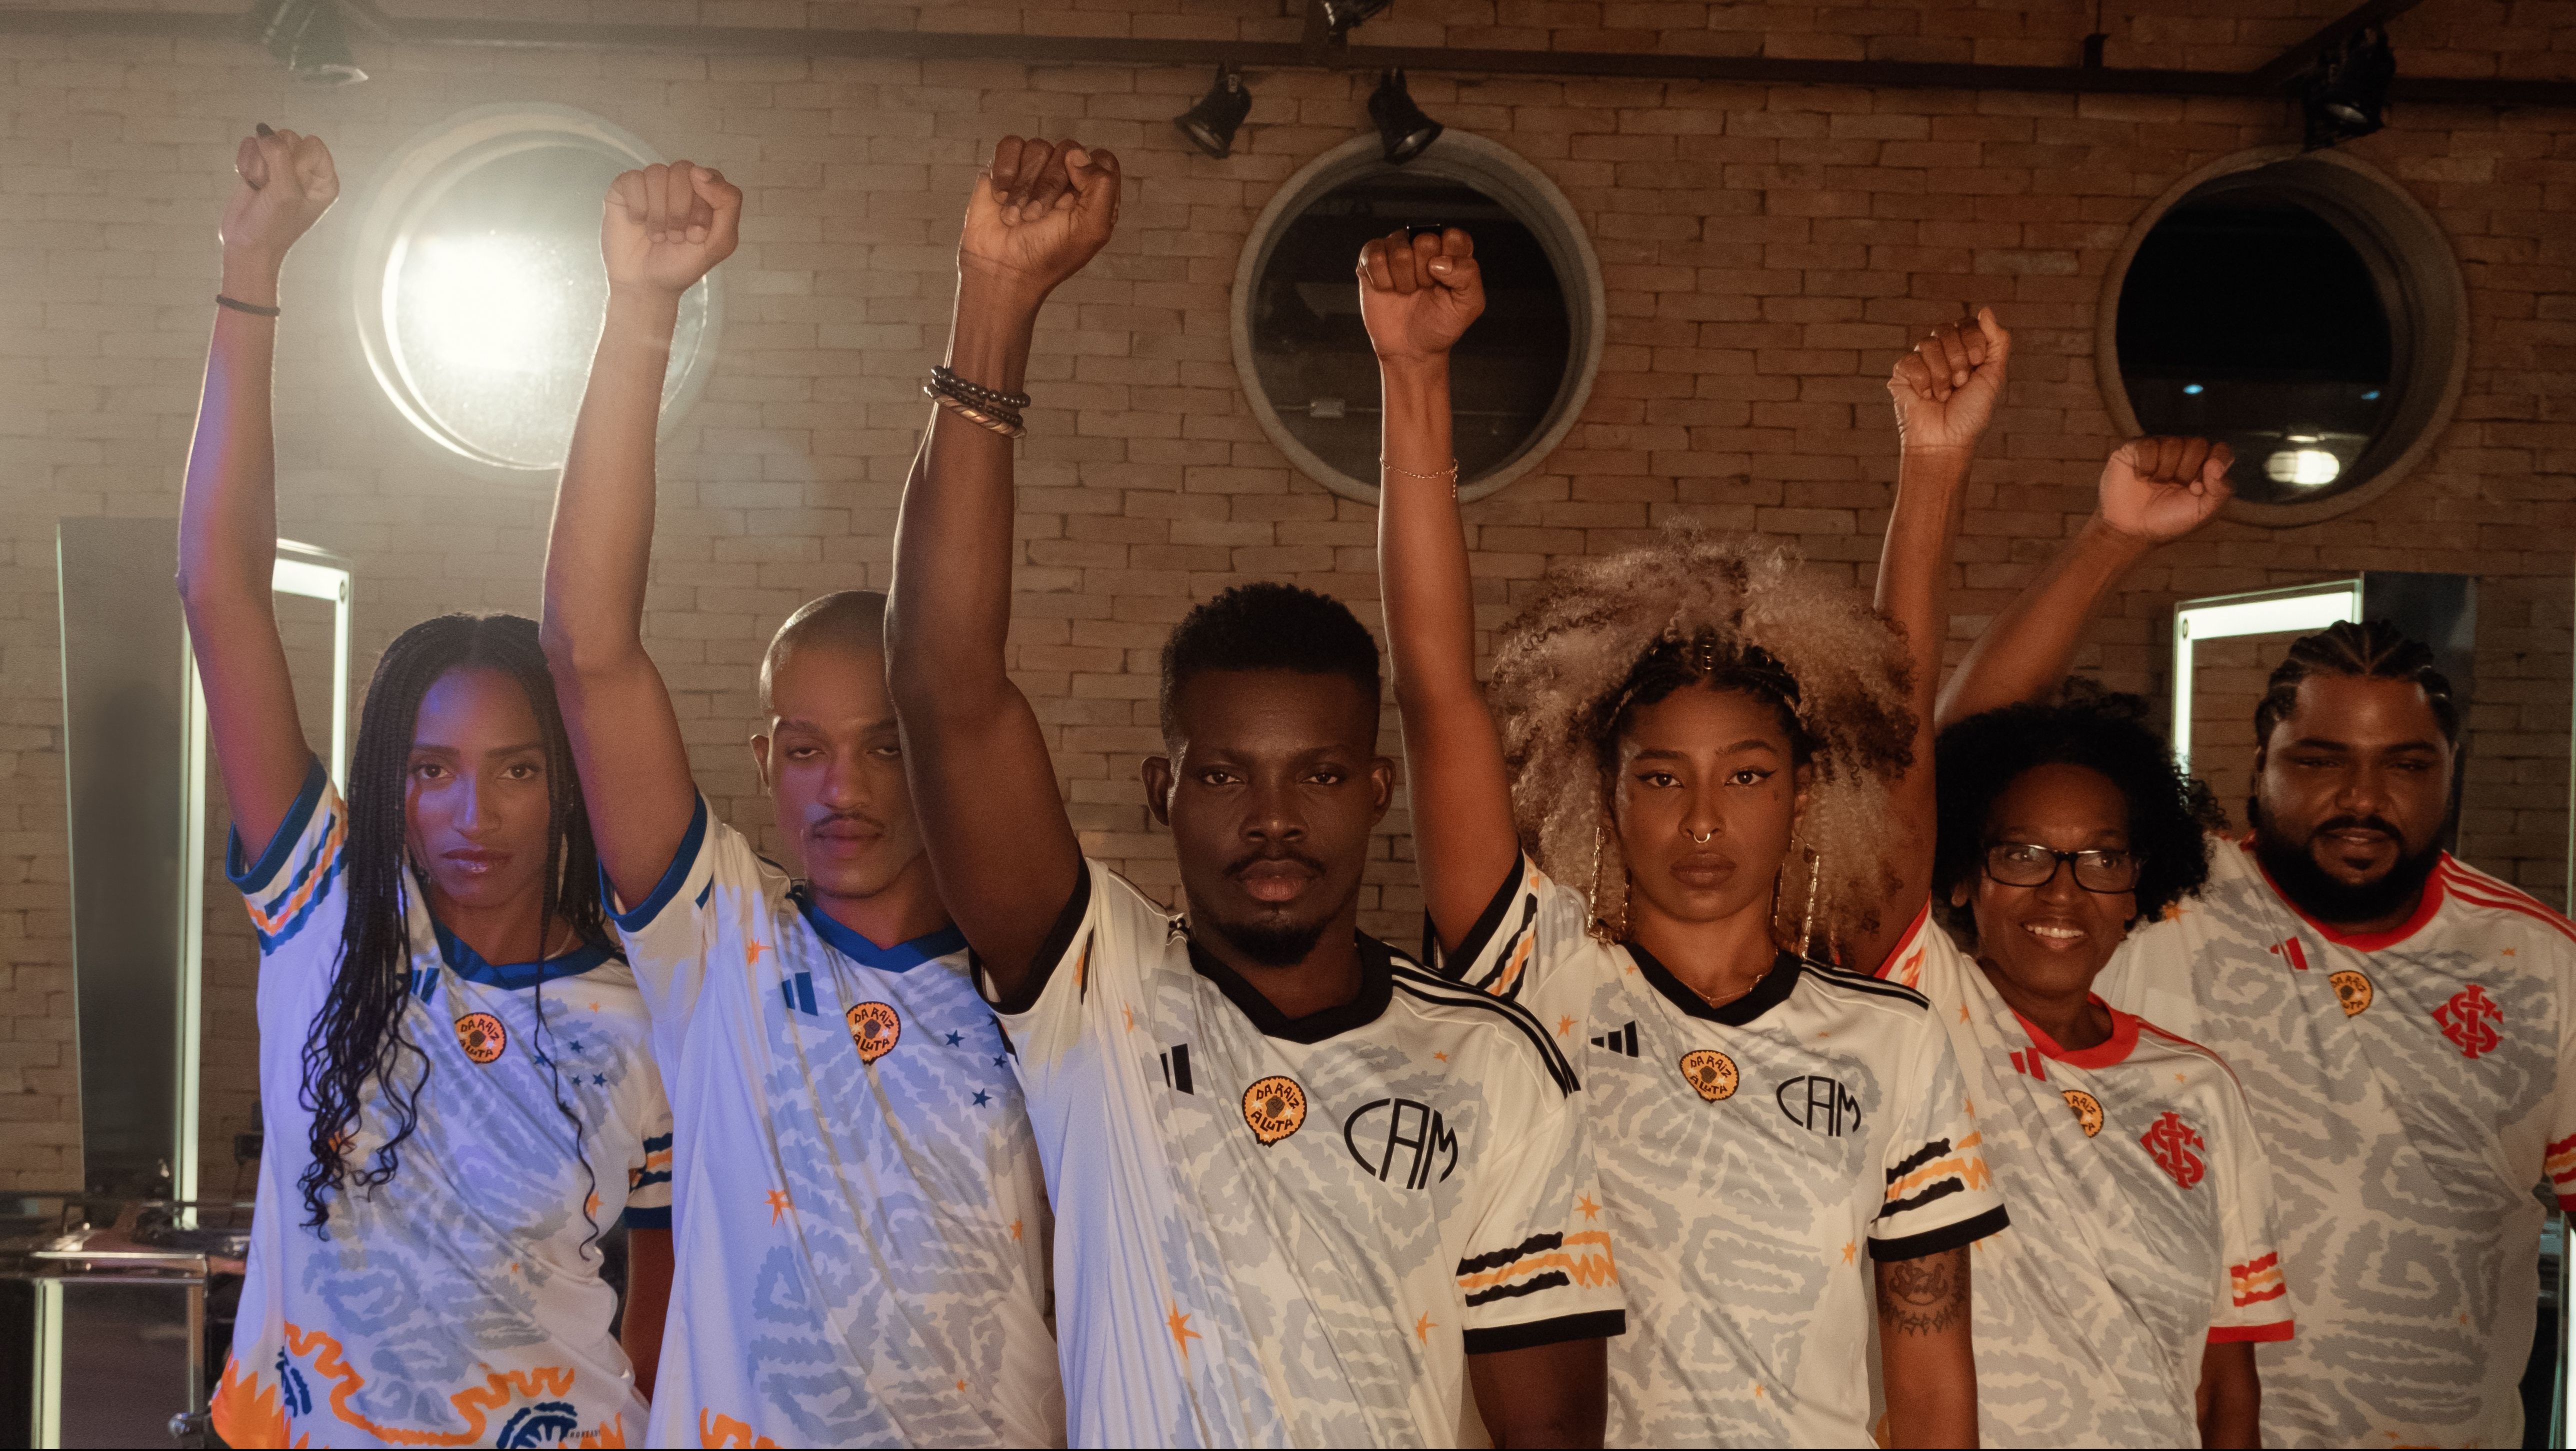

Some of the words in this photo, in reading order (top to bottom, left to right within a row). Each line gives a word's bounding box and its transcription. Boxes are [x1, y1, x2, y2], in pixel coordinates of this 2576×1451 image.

[854, 1008, 869, 1024] DA
[461, 1020, 476, 1032] DA
[860, 1038, 890, 1052] LUTA
[1690, 1056, 1704, 1068] DA
[1256, 1084, 1272, 1101] DA
[1699, 1081, 1728, 1094] LUTA
[1776, 1075, 1862, 1136] CAM
[1260, 1116, 1294, 1132] LUTA
[1344, 1098, 1458, 1190] CAM
